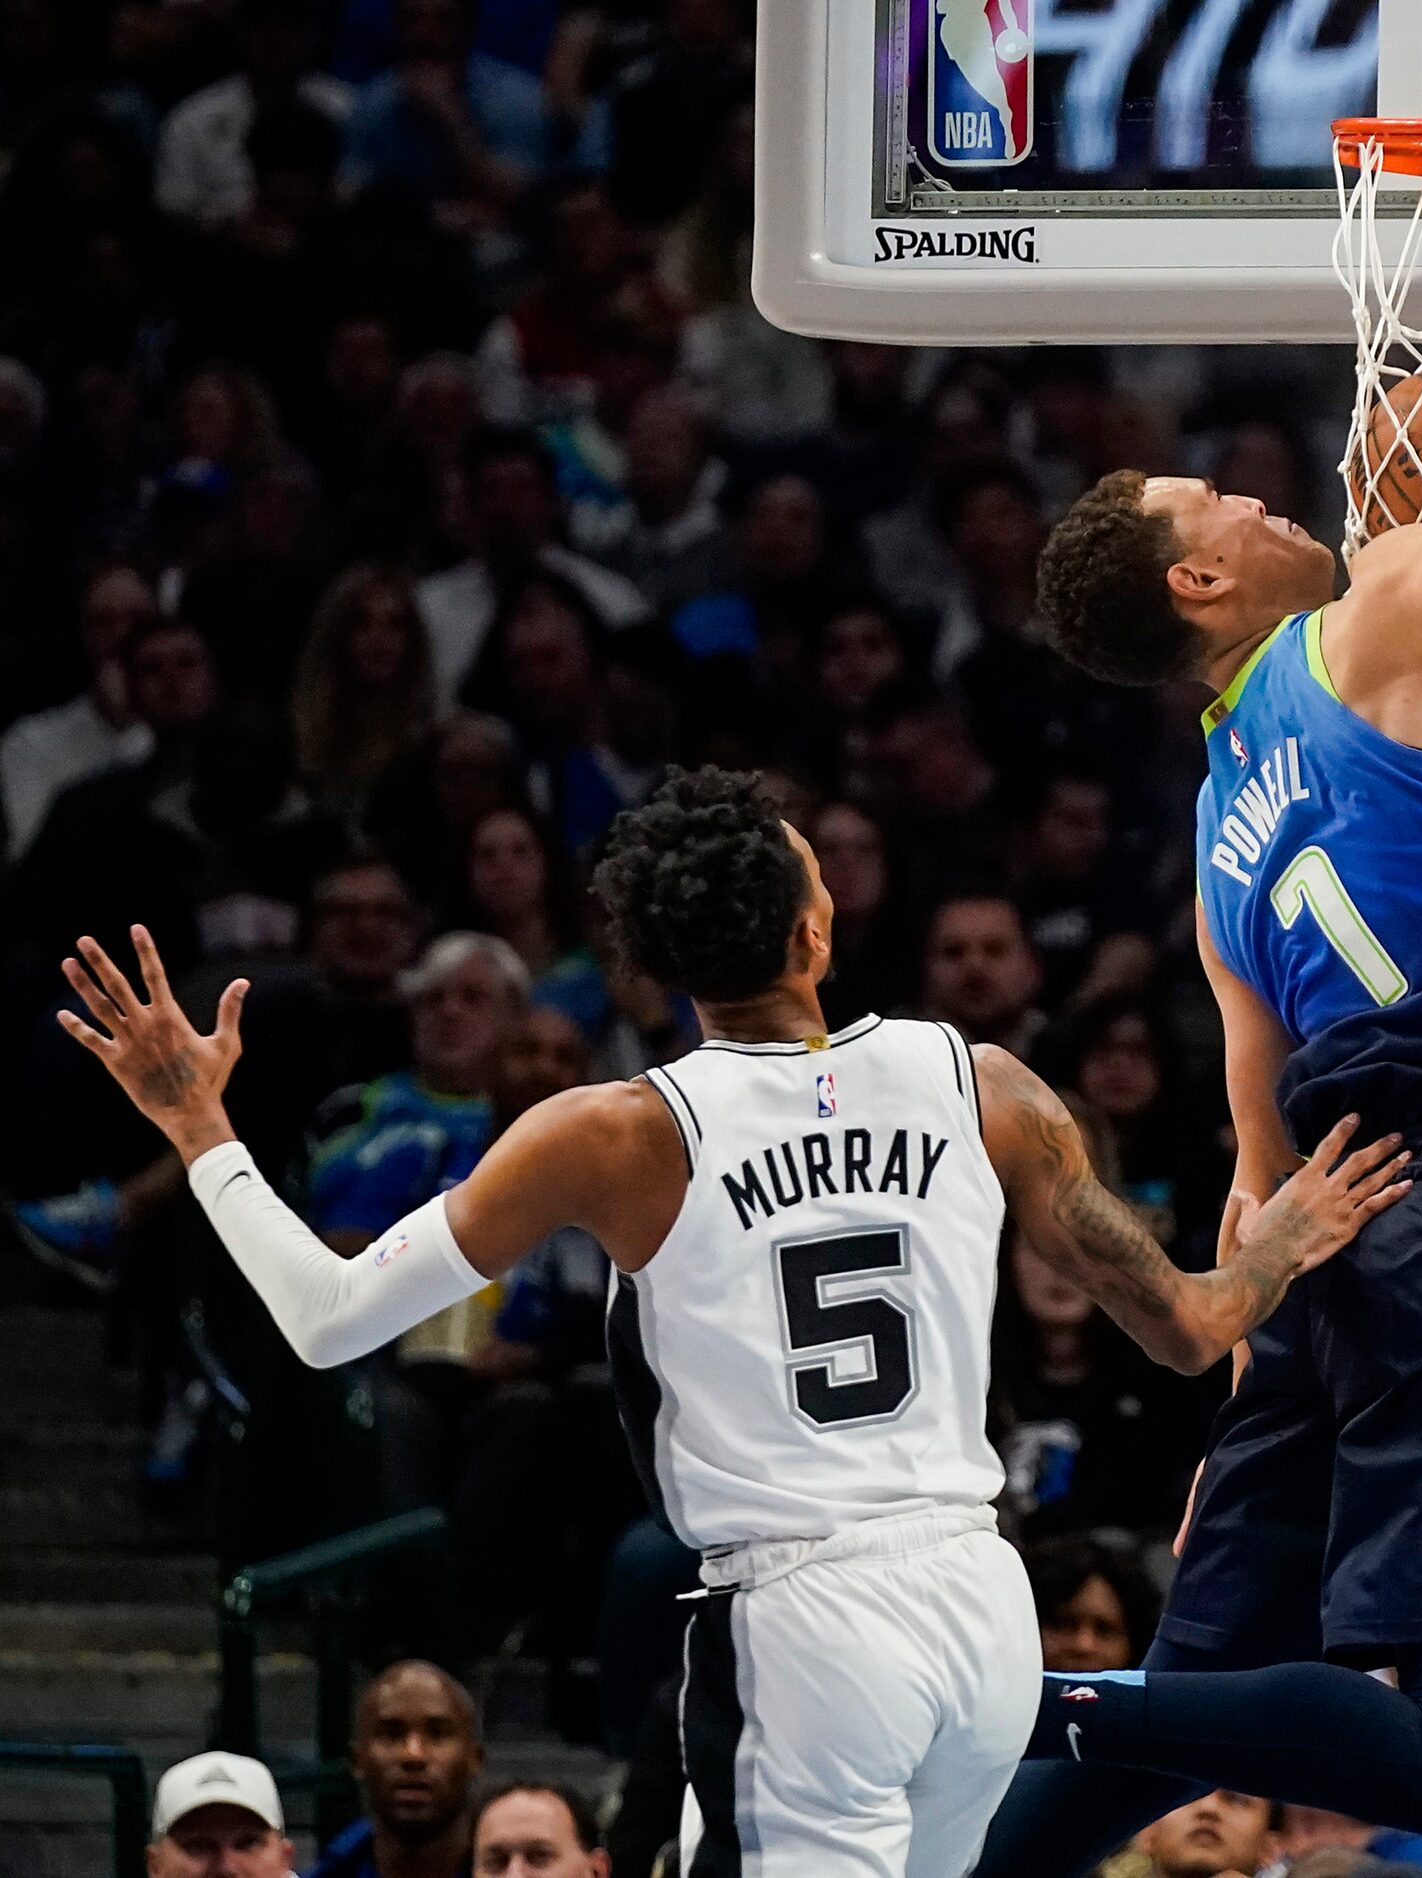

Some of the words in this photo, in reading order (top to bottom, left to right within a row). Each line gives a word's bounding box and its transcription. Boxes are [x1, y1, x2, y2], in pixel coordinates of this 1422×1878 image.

[945, 111, 993, 149] NBA
[874, 226, 1036, 263] SPALDING
[1211, 736, 1310, 887] POWELL
[1270, 845, 1409, 1008] 7
[720, 1127, 950, 1231] MURRAY
[770, 1222, 921, 1435] 5
